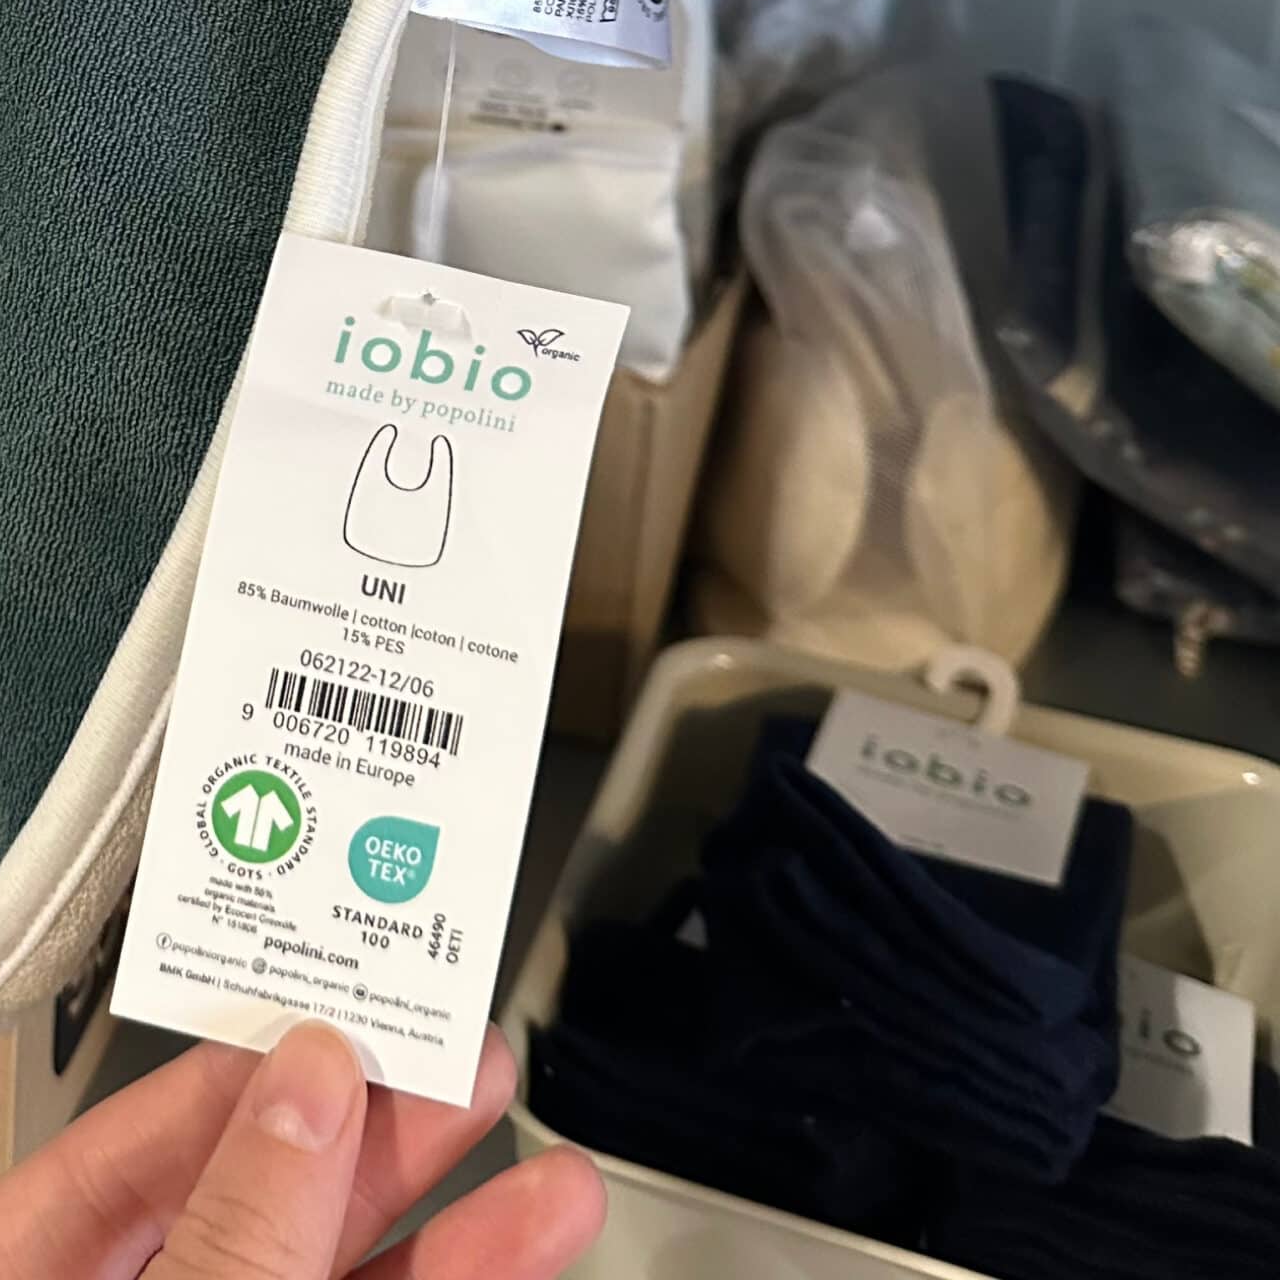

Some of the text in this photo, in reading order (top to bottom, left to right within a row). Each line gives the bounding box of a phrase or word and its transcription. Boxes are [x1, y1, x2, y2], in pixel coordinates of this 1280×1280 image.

[333, 316, 532, 401] iobio
[541, 346, 581, 363] organic
[325, 379, 516, 433] made by popolini
[361, 574, 407, 605] UNI
[237, 581, 268, 600] 85%
[270, 589, 350, 622] Baumwolle
[360, 612, 408, 636] cotton
[467, 640, 520, 664] cotone
[342, 627, 406, 655] 15% PES
[300, 649, 435, 699] 062122-12/06
[241, 703, 442, 769] 9 006720 119894
[284, 742, 416, 788] made in Europe
[859, 733, 1032, 808] iobio
[196, 753, 318, 876] GLOBAL ORGANIC TEXTILE STANDARD
[227, 862, 263, 880] GOTS
[365, 836, 422, 865] OEKO
[332, 904, 424, 940] STANDARD
[361, 930, 390, 950] 100
[427, 912, 446, 960] 46490
[264, 935, 360, 970] popolini.com
[446, 928, 464, 964] OETI
[160, 962, 184, 977] BMK
[185, 969, 216, 985] GmbH
[223, 978, 311, 1011] Schuhfabrikgasse
[313, 1001, 337, 1016] 17/2
[343, 1009, 368, 1025] 1230
[407, 1027, 444, 1046] Austria
